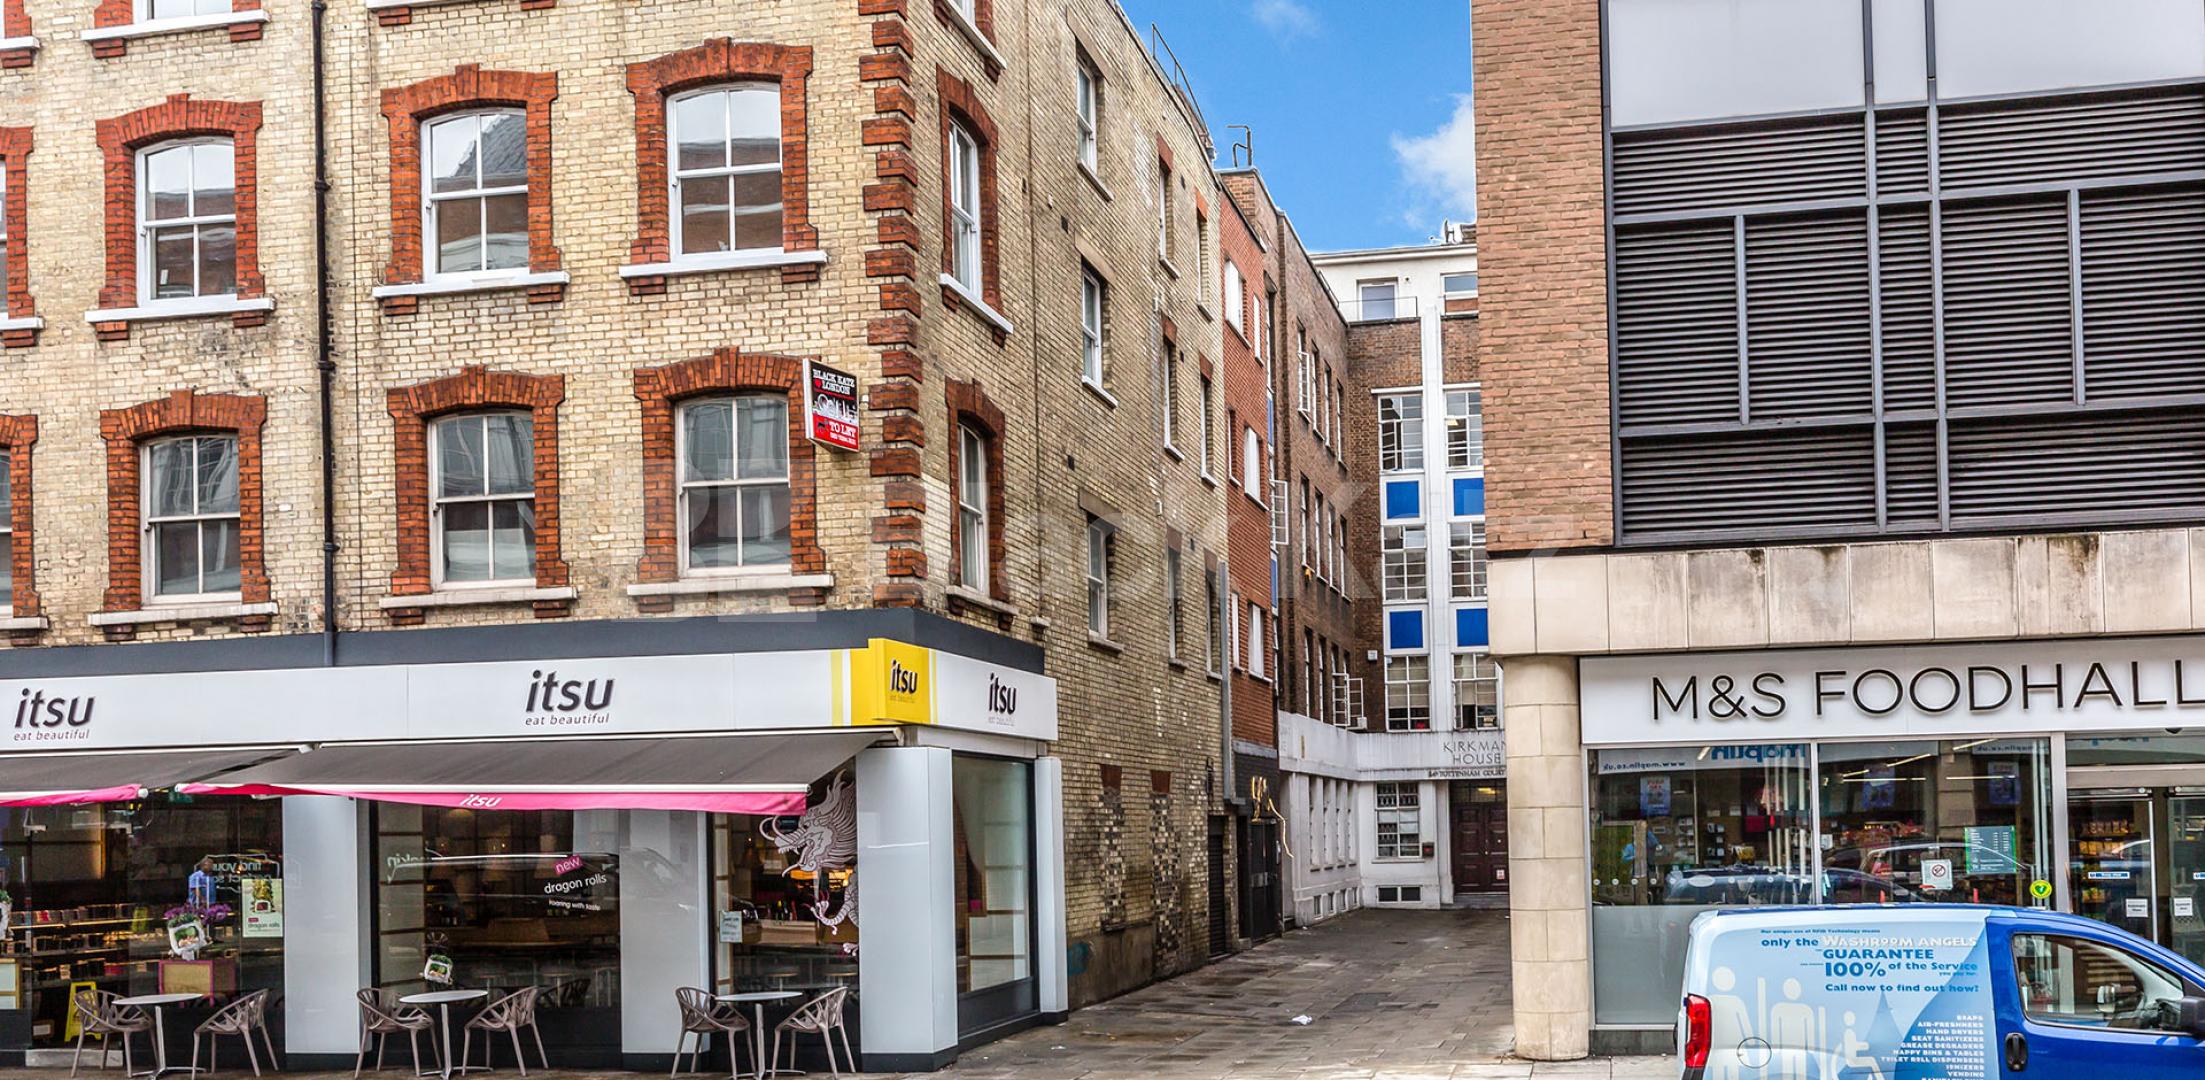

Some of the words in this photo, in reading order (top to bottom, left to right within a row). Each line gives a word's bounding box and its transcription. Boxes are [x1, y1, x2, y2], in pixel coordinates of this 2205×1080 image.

[822, 380, 850, 394] LONDON
[829, 420, 840, 433] TO
[841, 423, 857, 438] LET
[890, 660, 918, 694] itsu
[526, 669, 615, 712] itsu
[988, 673, 1017, 715] itsu
[1651, 671, 1786, 720] M&S
[1815, 661, 2205, 716] FOODHALL
[14, 688, 96, 728] itsu
[525, 716, 545, 726] eat
[550, 713, 610, 725] beautiful
[14, 731, 32, 741] eat
[37, 729, 91, 741] beautiful
[1453, 753, 1501, 765] HOUSE
[1482, 769, 1505, 777] COURT
[460, 794, 502, 808] itsu
[555, 856, 580, 873] new
[544, 879, 583, 893] dragon
[585, 874, 607, 886] rolls
[1761, 937, 1790, 948] only
[1795, 937, 1818, 947] the
[1918, 936, 1977, 947] ANGELS
[1823, 949, 1934, 959] GUARANTEE
[1825, 962, 1887, 977] 100%
[1888, 962, 1902, 970] of
[1905, 962, 1927, 970] the
[1931, 962, 1978, 970] Service
[1826, 983, 1848, 992] Call
[1880, 984, 1893, 992] to
[1897, 983, 1920, 992] find
[1925, 984, 1945, 992] out
[1949, 984, 1979, 993] how!
